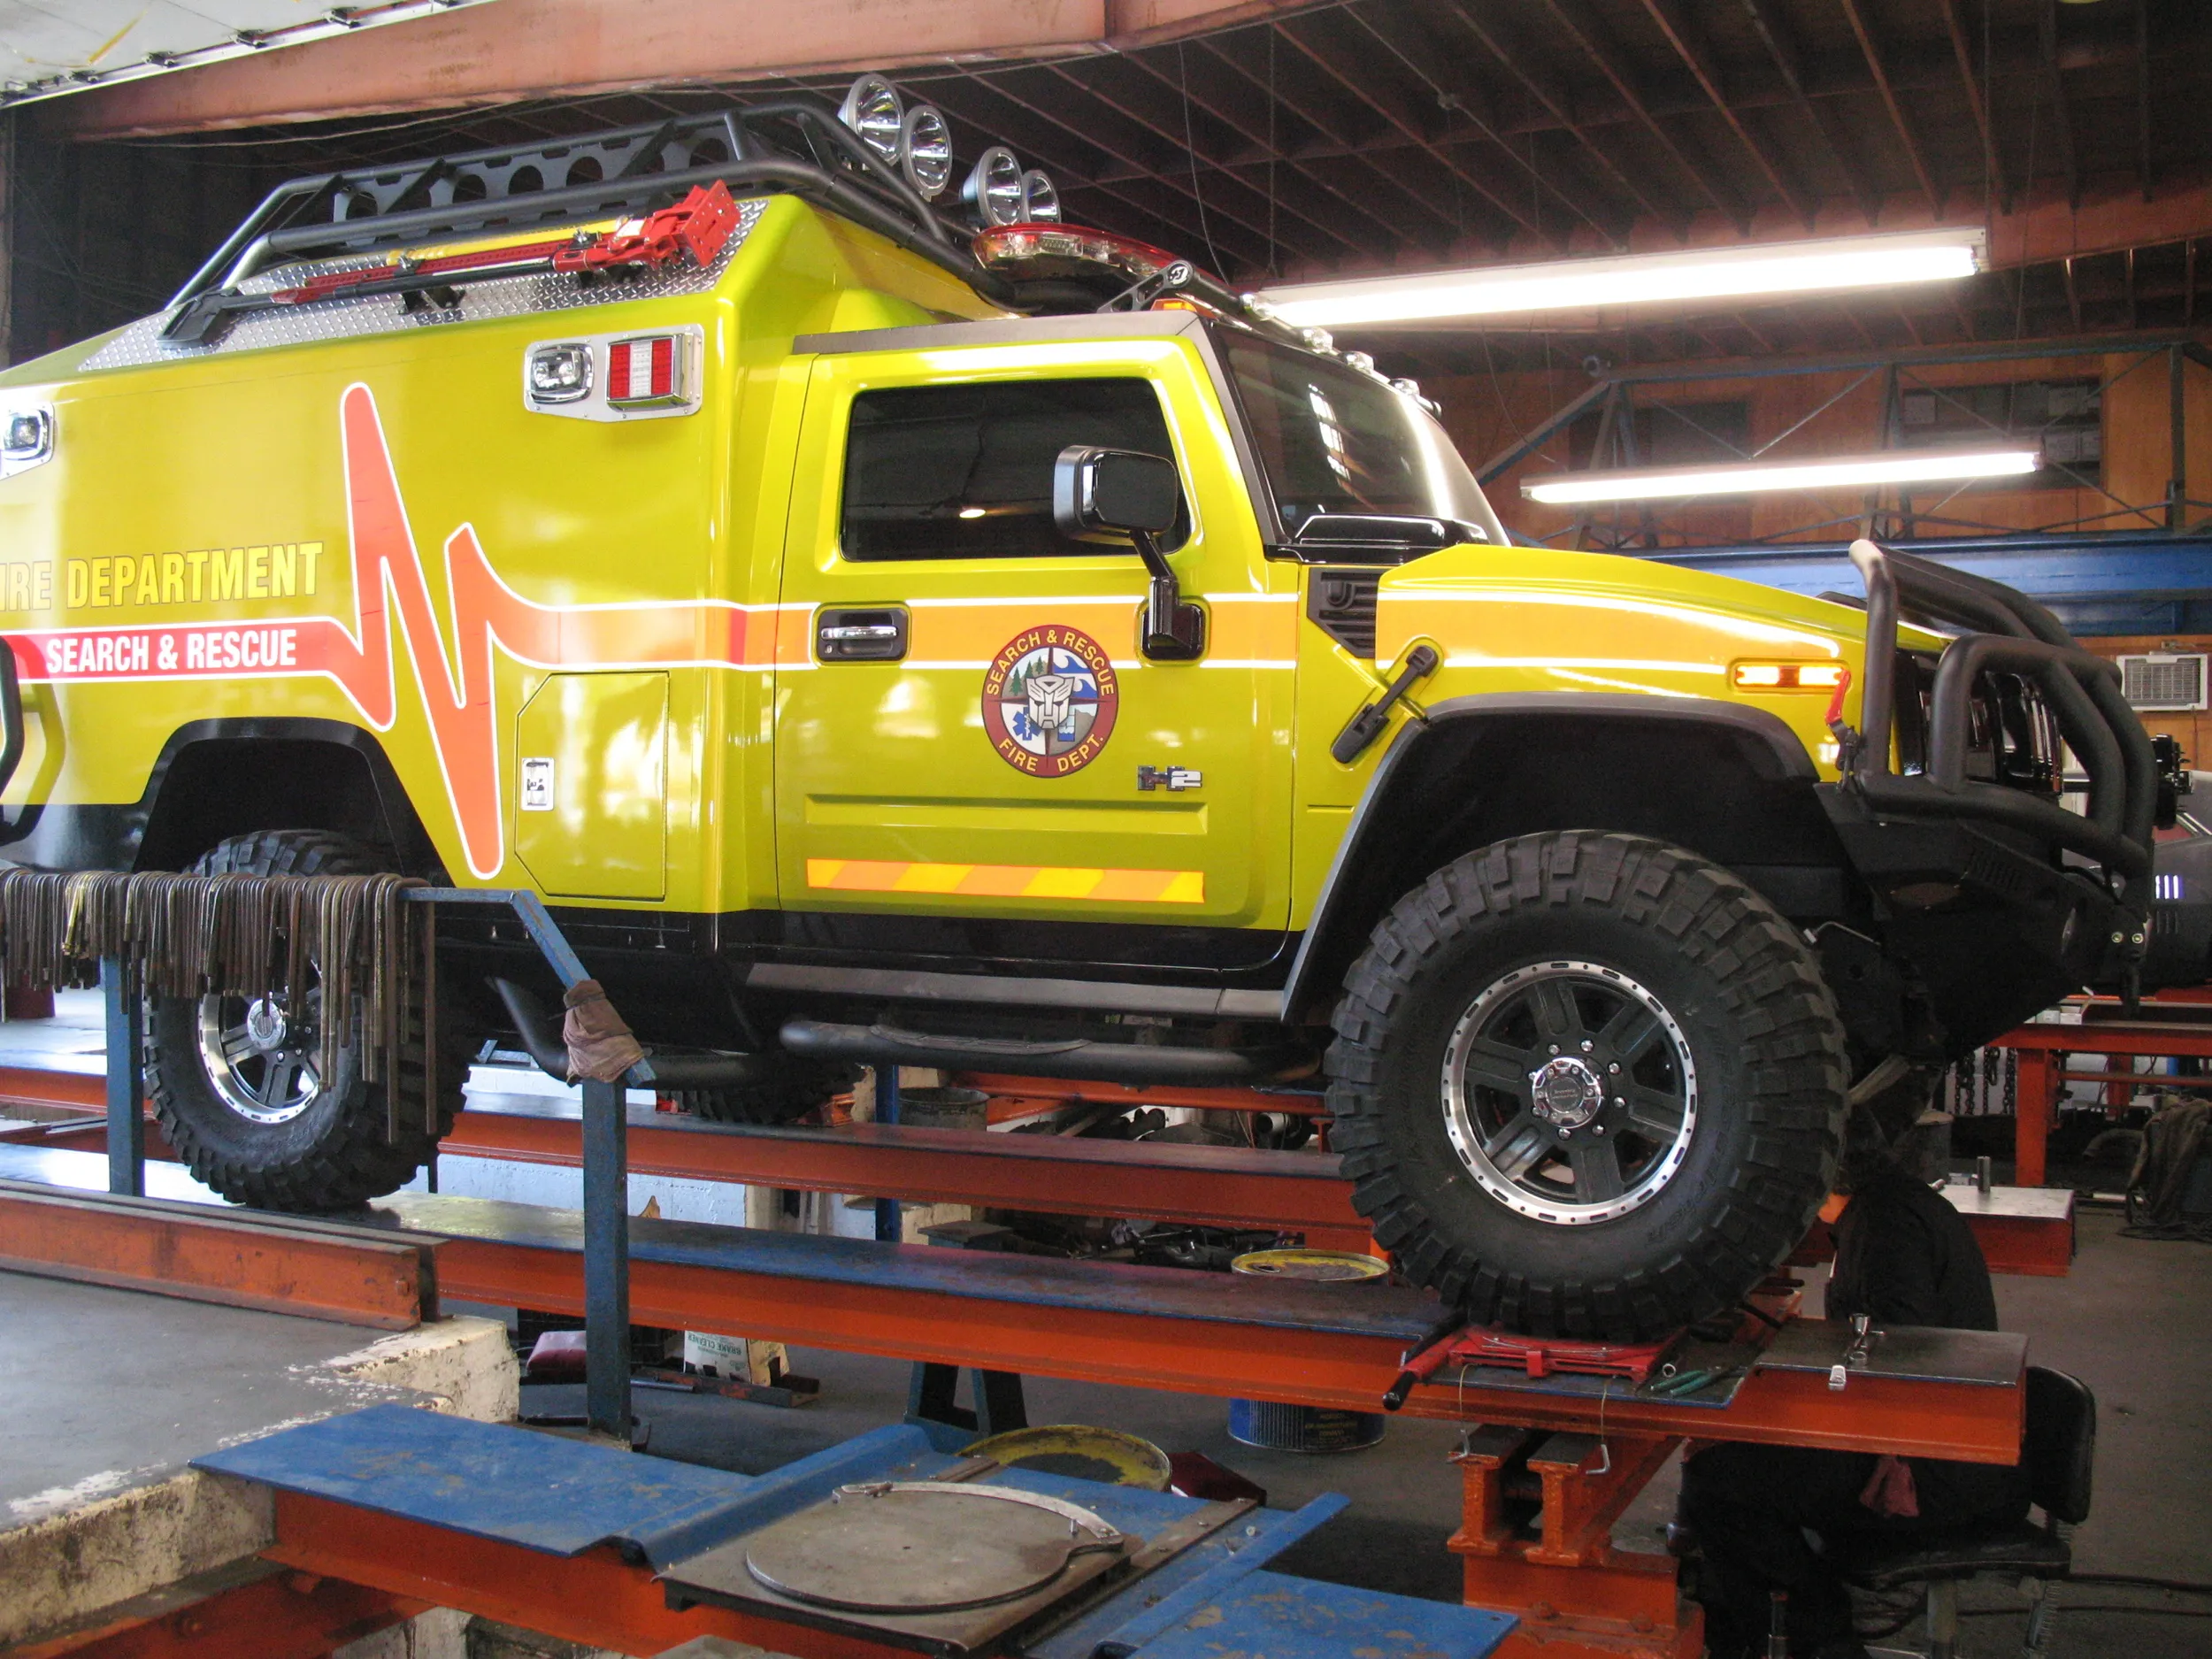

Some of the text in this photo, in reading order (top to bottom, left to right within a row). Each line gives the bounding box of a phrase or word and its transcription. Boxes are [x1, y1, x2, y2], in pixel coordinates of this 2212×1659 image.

[66, 541, 324, 610] DEPARTMENT
[47, 630, 296, 672] SEARCH & RESCUE
[987, 629, 1114, 696] SEARCH & RESCUE
[1000, 736, 1103, 772] FIRE DEPT.
